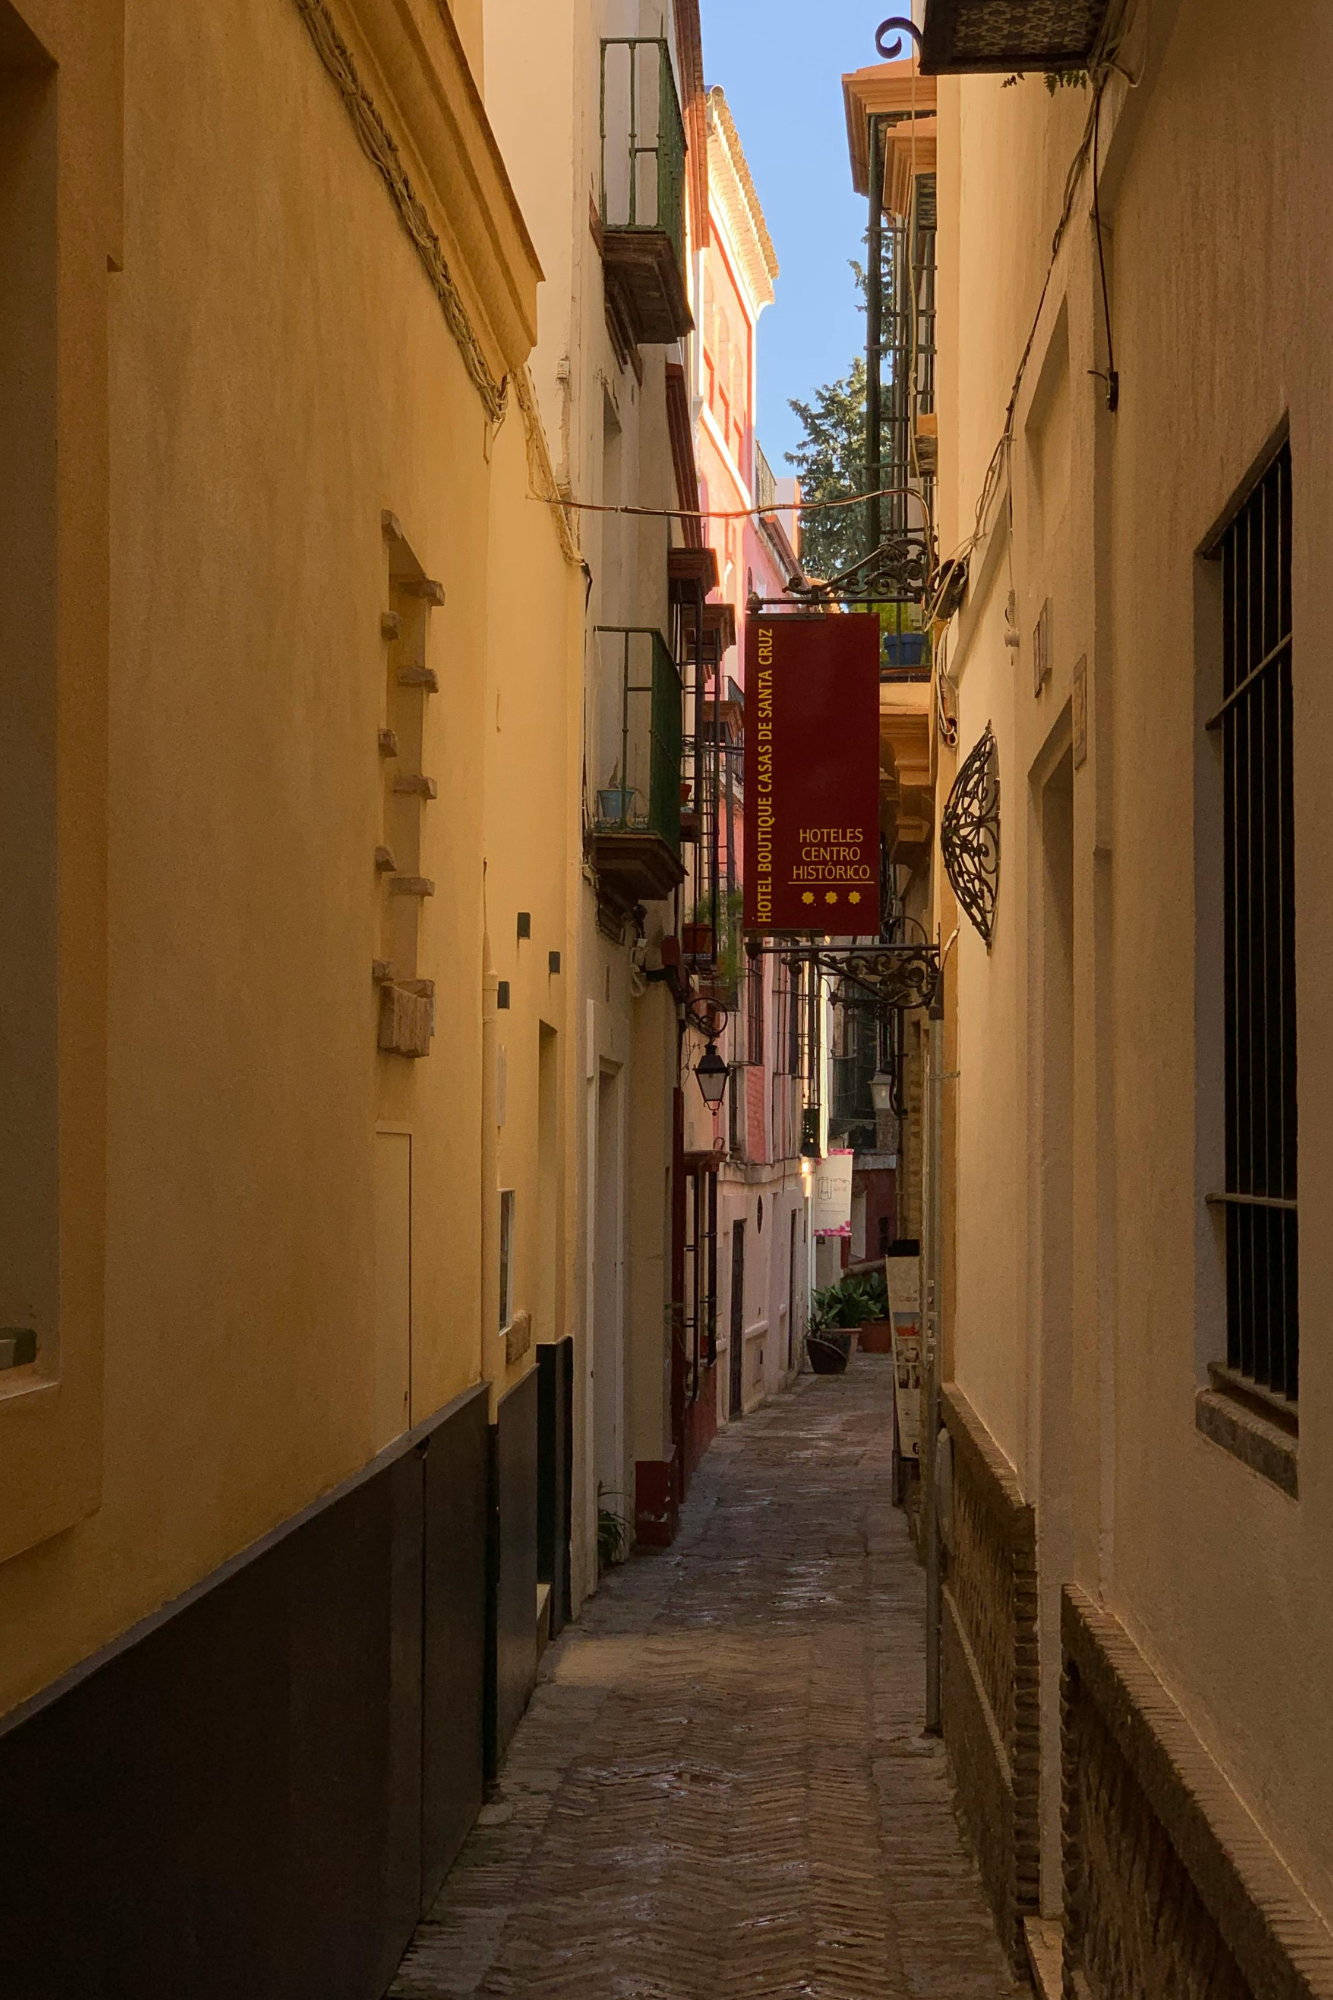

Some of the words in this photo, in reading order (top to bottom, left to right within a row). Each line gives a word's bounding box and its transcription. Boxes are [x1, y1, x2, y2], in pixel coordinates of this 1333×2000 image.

[757, 629, 773, 666] CRUZ
[757, 670, 773, 718] SANTA
[757, 722, 773, 741] DE
[757, 745, 773, 793] CASAS
[757, 797, 776, 872] BOUTIQUE
[799, 829, 864, 843] HOTELES
[792, 862, 871, 880] HISTÓRICO
[801, 847, 861, 862] CENTRO
[756, 877, 772, 923] HOTEL
